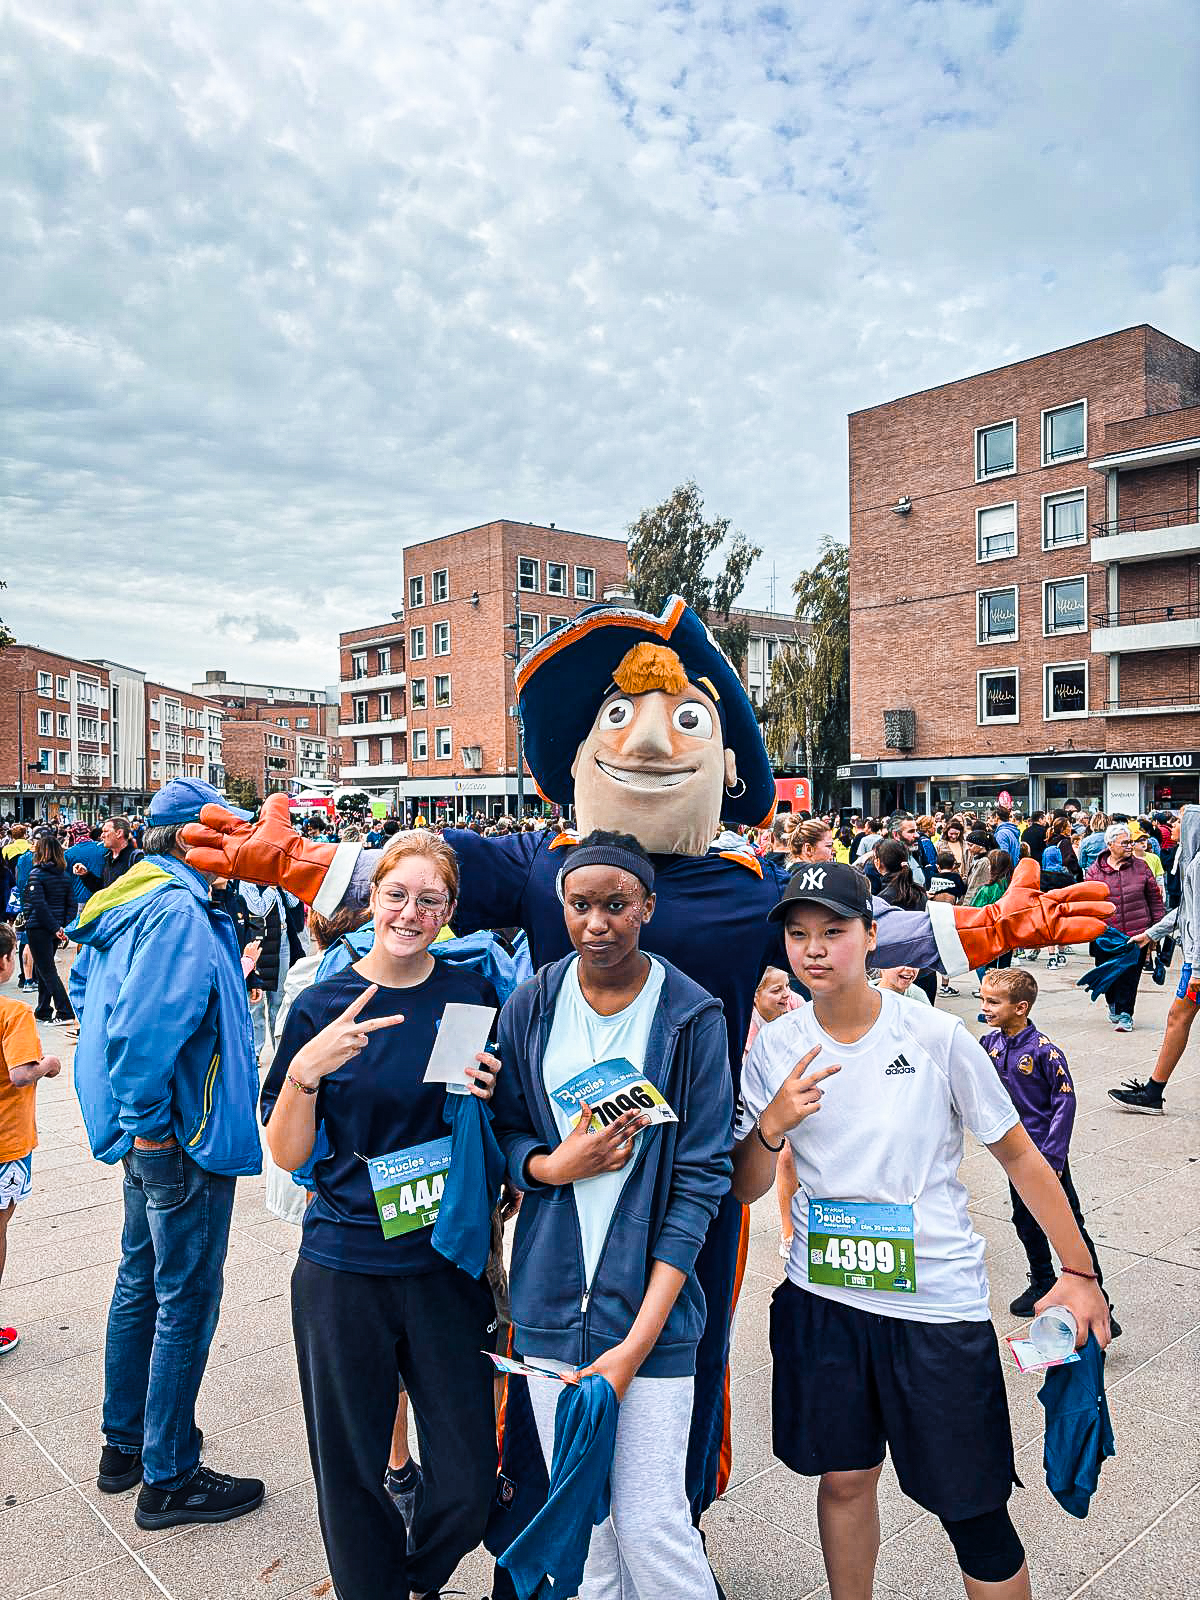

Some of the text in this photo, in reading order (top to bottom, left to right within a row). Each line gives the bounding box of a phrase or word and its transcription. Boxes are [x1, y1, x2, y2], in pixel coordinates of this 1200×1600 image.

[799, 867, 827, 890] NY
[885, 1067, 916, 1075] adidas
[556, 1078, 605, 1105] Boucles
[373, 1158, 424, 1178] Boucles
[400, 1174, 448, 1215] 444
[812, 1204, 857, 1225] Boucles
[825, 1237, 894, 1274] 4399
